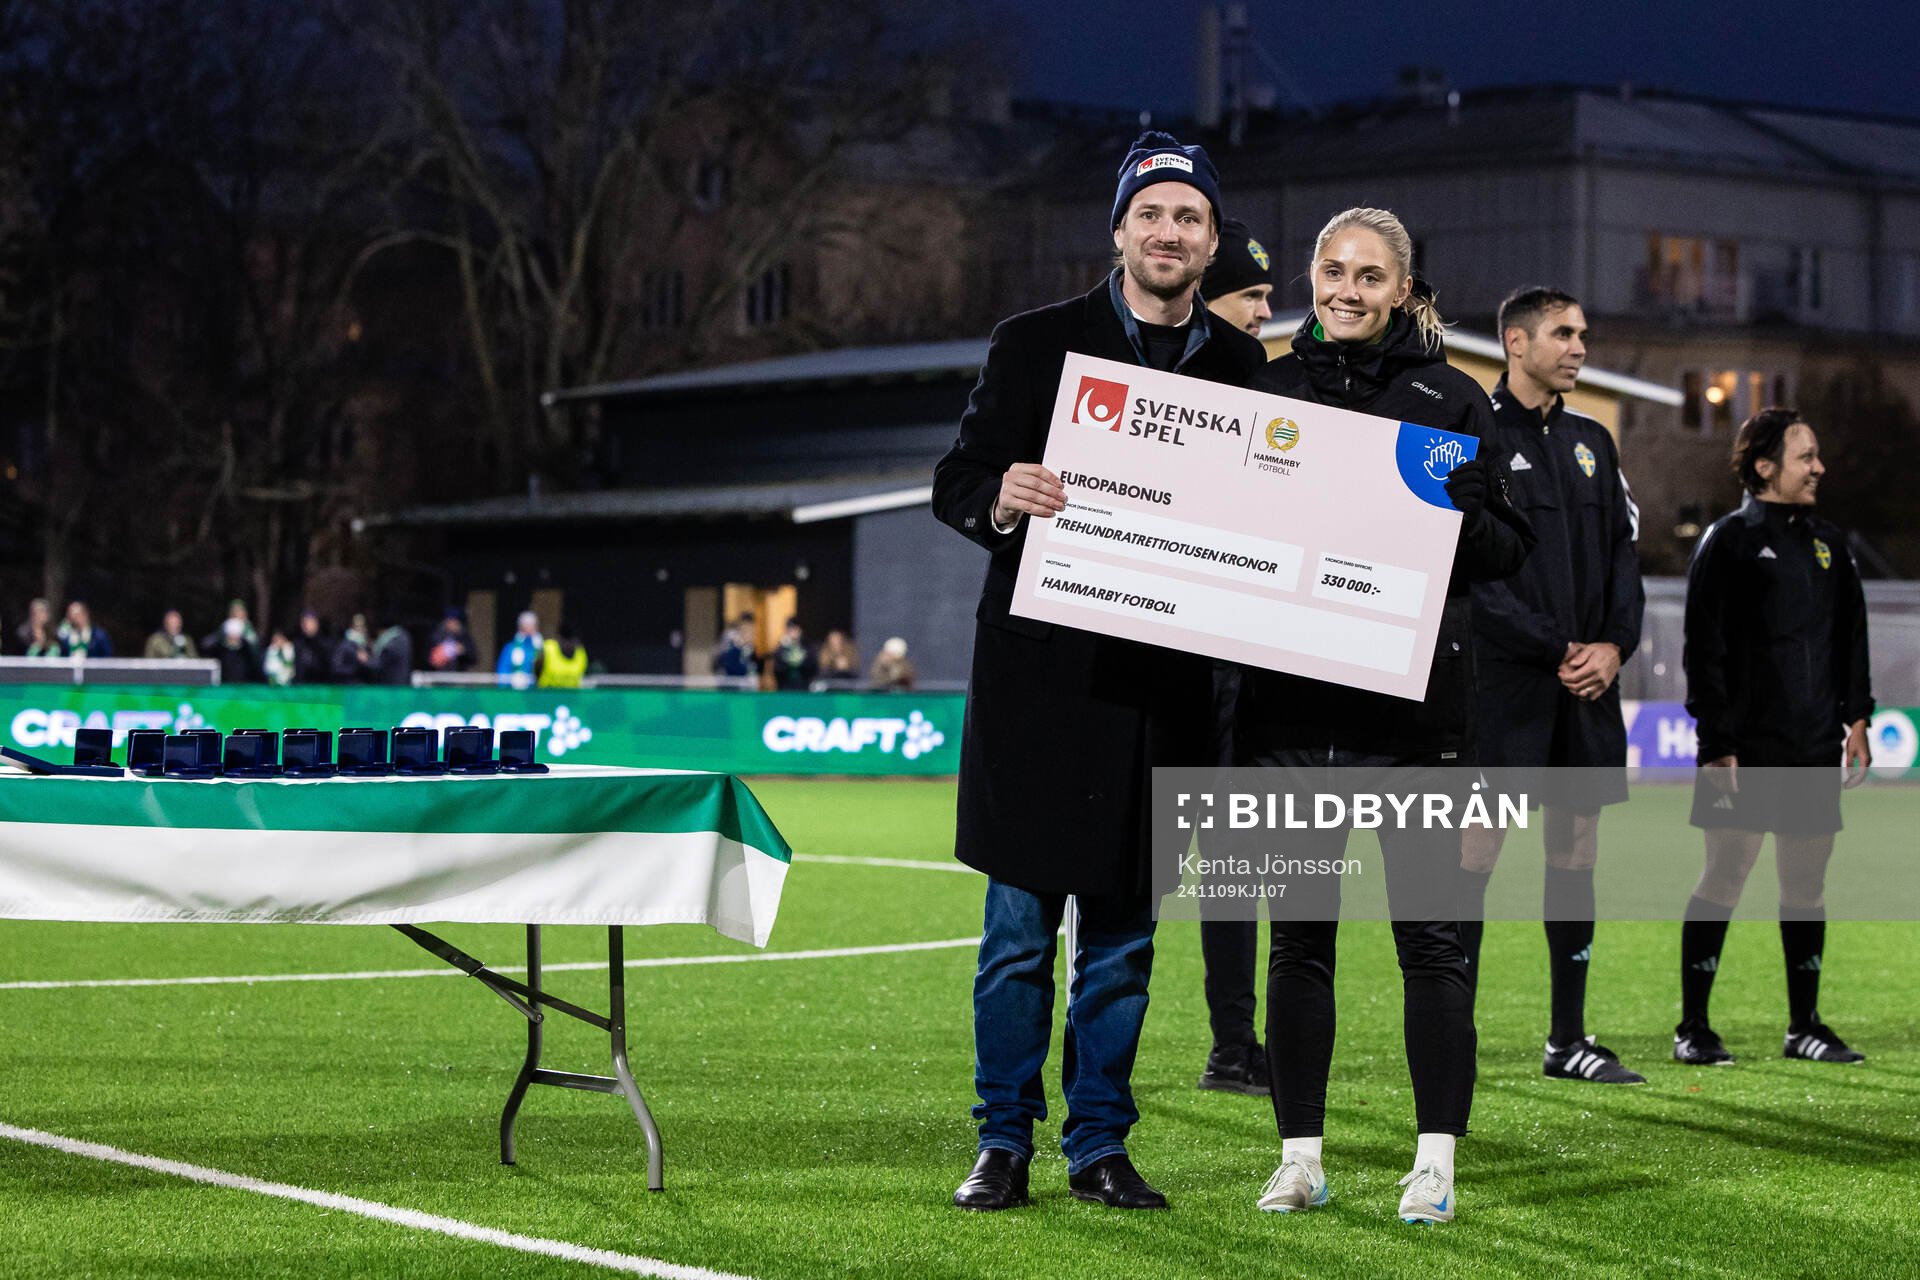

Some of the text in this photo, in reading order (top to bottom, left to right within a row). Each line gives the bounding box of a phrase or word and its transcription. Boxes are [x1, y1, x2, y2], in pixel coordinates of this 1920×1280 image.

[1155, 157, 1190, 167] SVENSKA
[1411, 381, 1438, 396] CRAFT
[1133, 398, 1242, 436] SVENSKA
[1129, 419, 1185, 446] SPEL
[1253, 453, 1301, 468] HAMMARBY
[1258, 463, 1291, 476] FOTBOLL
[1060, 470, 1172, 506] EUROPABONUS
[1055, 517, 1278, 574] TREHUNDRATRETTIOTUSEN KRONOR
[1321, 574, 1346, 588] 330
[1041, 576, 1177, 615] HAMMARBY FOTBOLL
[762, 715, 906, 752] CRAFT
